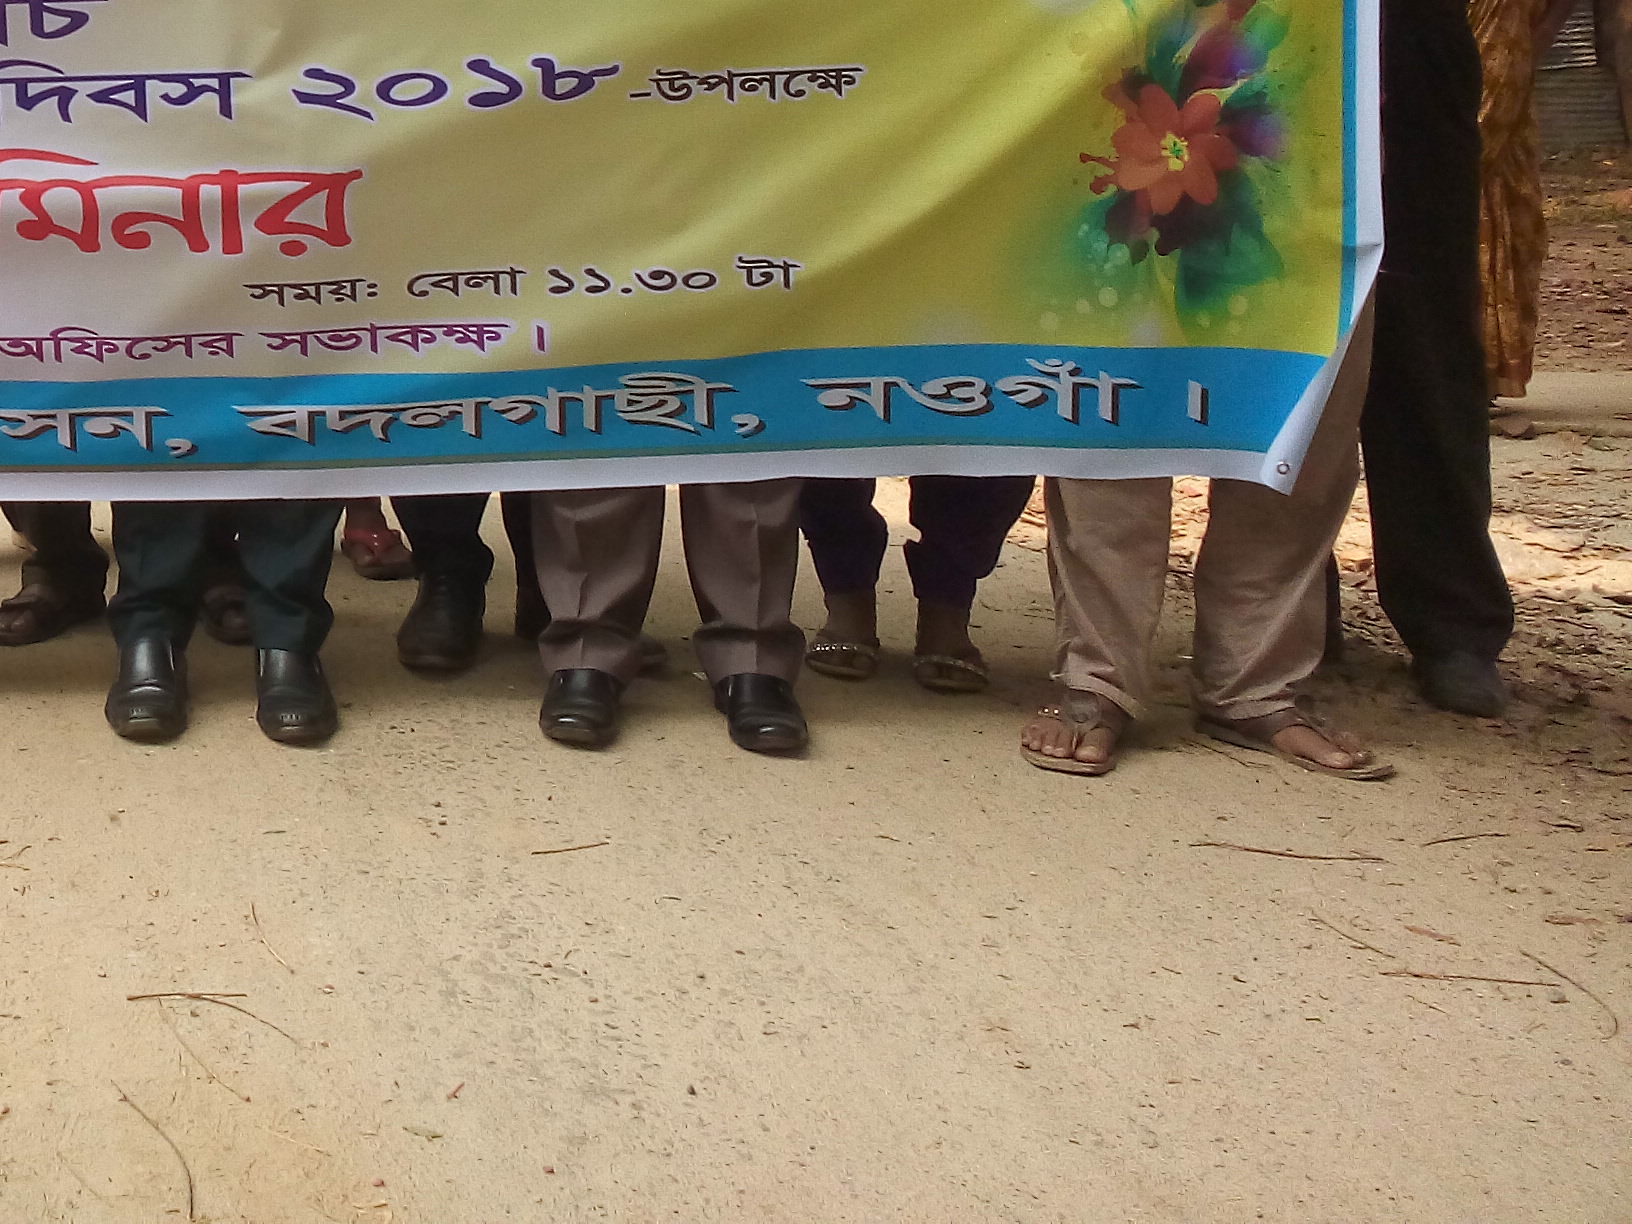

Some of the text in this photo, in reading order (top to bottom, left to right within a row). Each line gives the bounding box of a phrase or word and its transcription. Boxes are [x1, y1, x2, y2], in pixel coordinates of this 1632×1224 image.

[291, 57, 622, 121] ২০১৮
[406, 266, 527, 298] বেলা
[547, 266, 717, 296] ১১.৩০
[735, 257, 801, 290] টা
[258, 320, 511, 358] সভাকক্ষ
[230, 371, 767, 446] বদলগাছী,
[799, 357, 1143, 425] নওগাঁ
